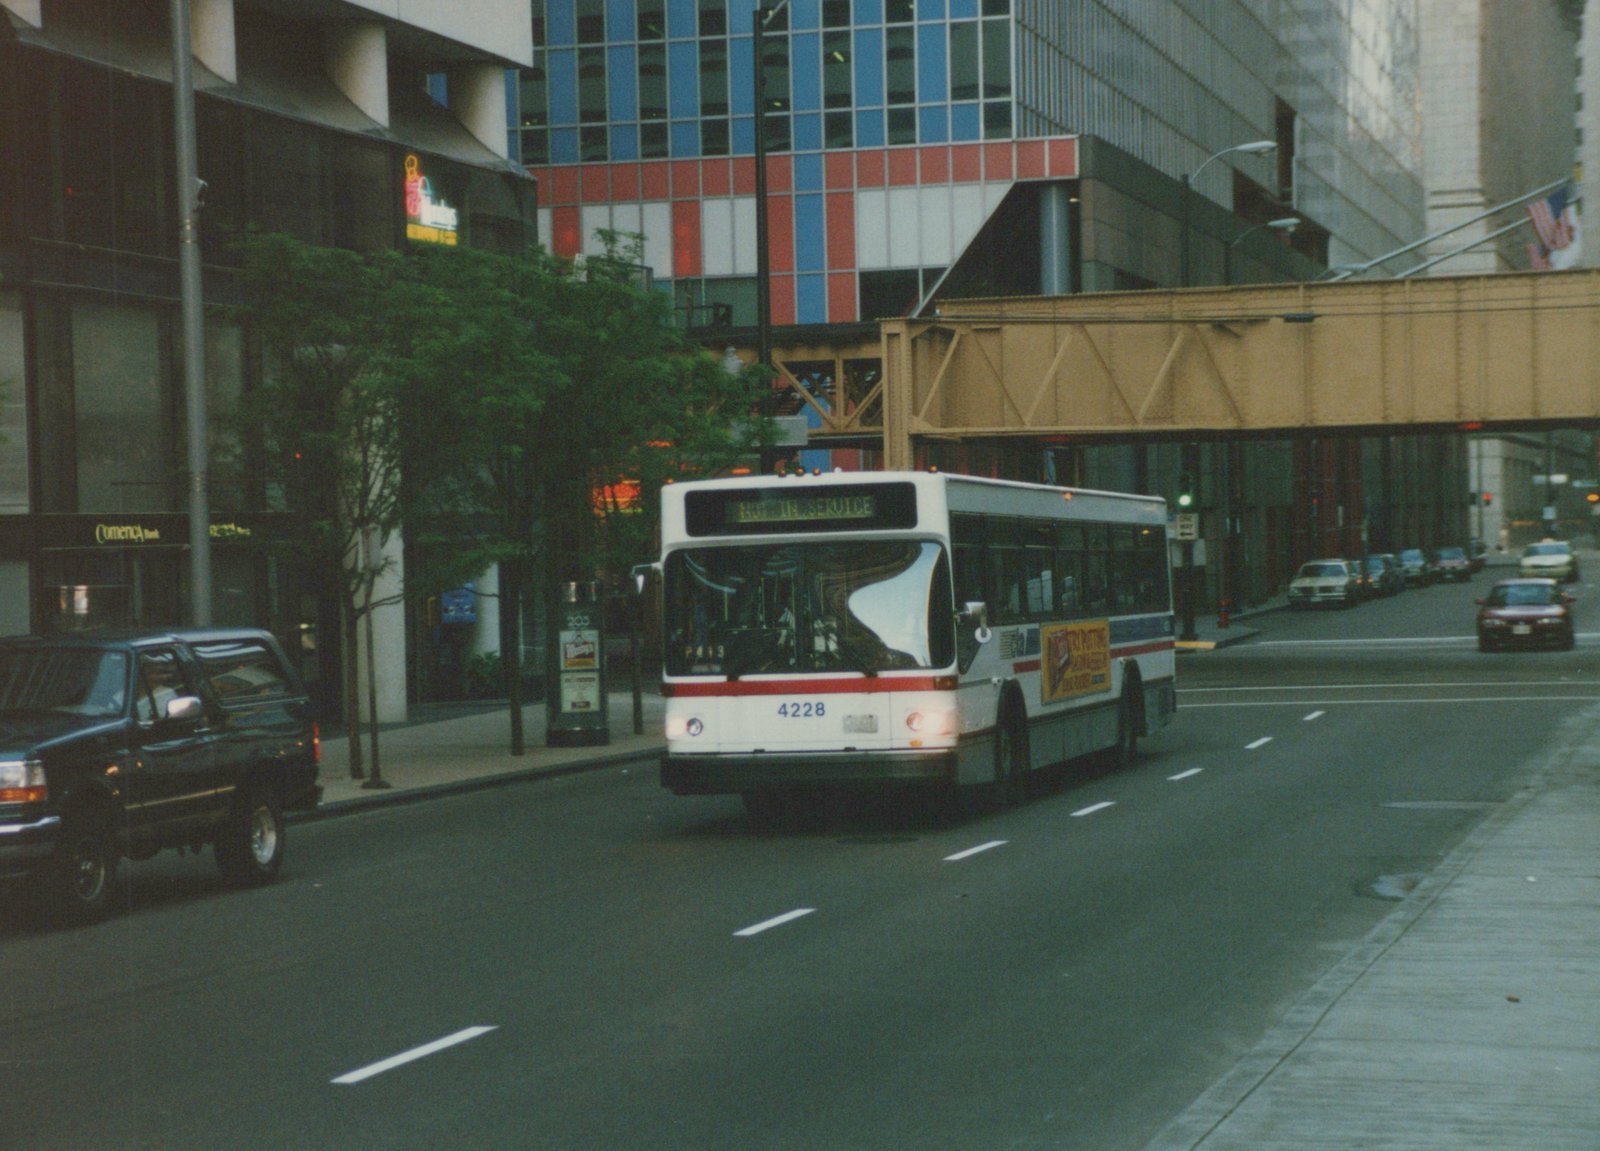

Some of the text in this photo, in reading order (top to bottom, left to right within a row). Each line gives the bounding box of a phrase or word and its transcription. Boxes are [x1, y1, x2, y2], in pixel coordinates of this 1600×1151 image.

[780, 499, 798, 517] IN
[807, 496, 873, 516] SERVICE
[778, 702, 825, 717] 4228
